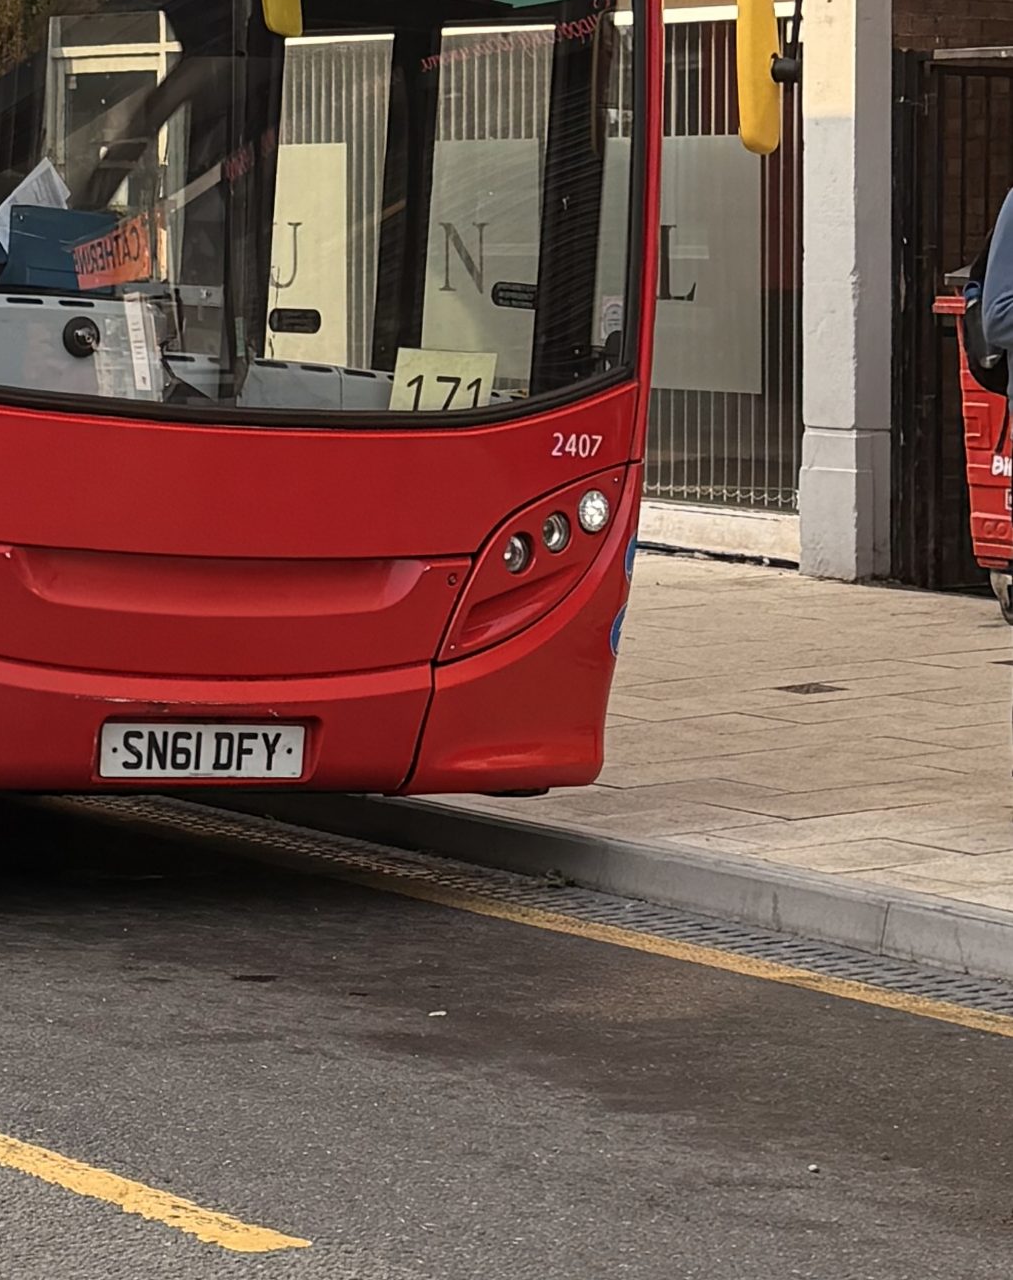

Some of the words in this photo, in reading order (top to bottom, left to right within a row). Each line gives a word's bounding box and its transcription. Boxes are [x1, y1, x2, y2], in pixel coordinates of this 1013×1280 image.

[406, 375, 482, 410] 171
[551, 432, 603, 458] 2407
[122, 730, 202, 770] SN61
[213, 732, 282, 771] DFY
